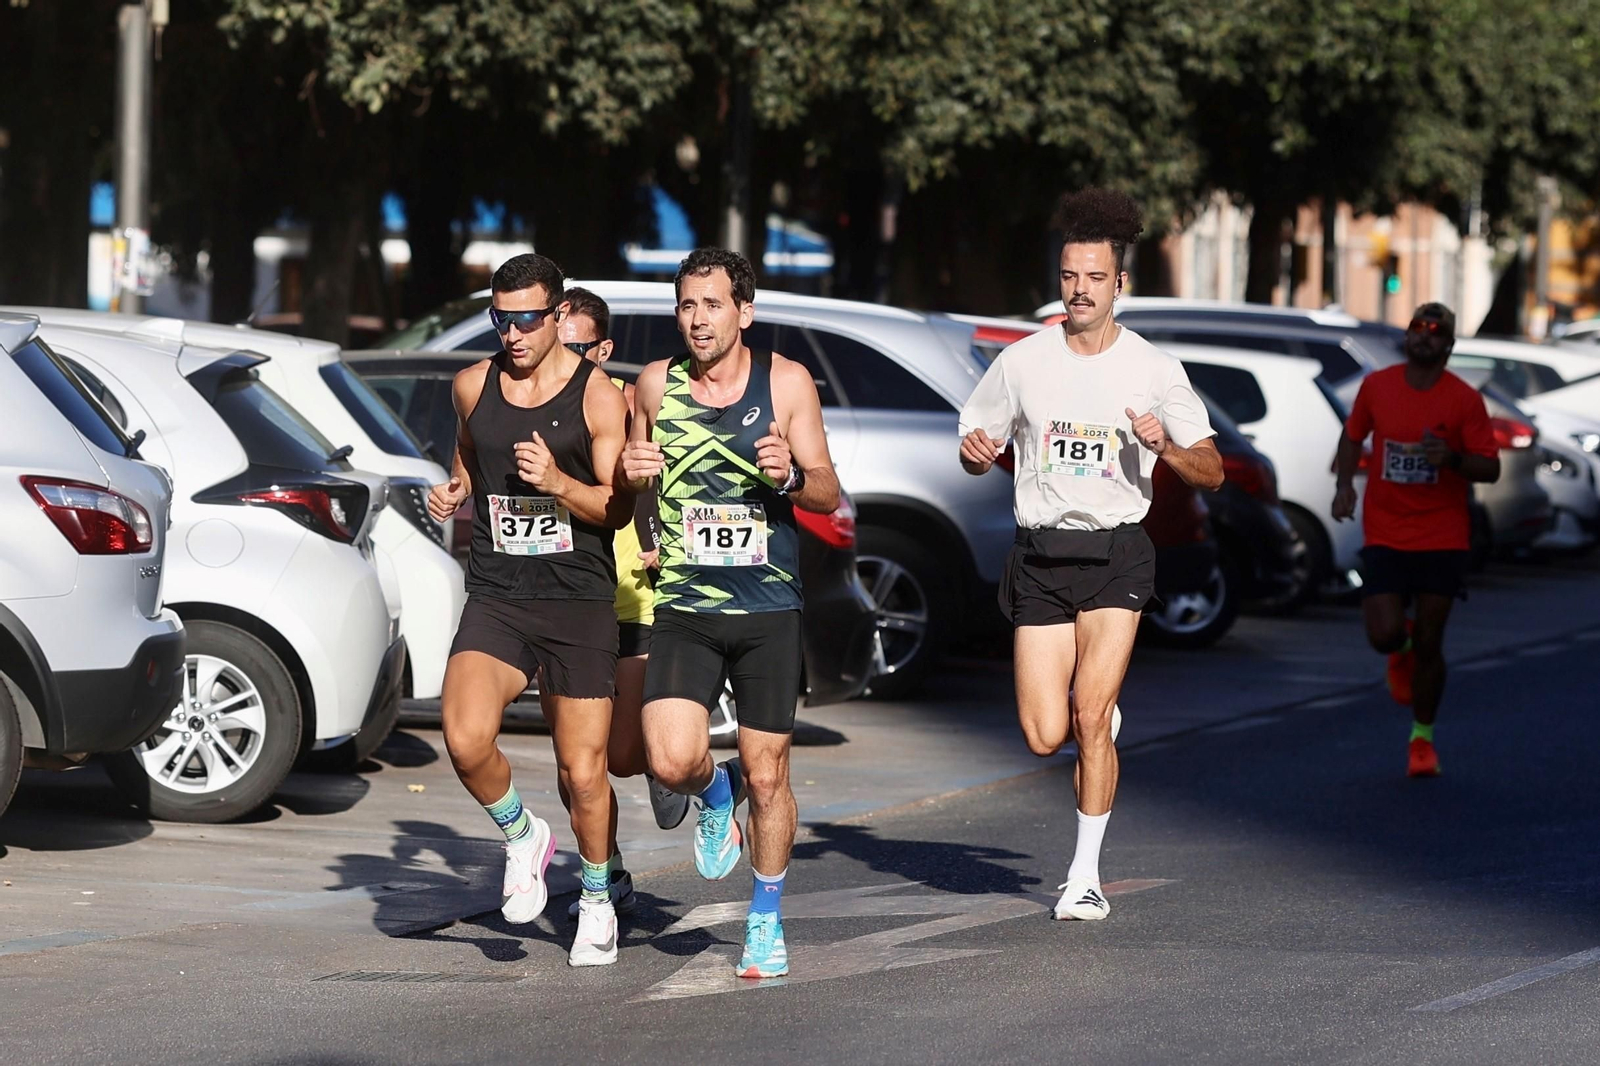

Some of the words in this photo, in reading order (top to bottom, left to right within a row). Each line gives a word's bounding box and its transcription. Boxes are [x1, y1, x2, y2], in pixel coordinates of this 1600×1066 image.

[1083, 429, 1109, 438] 2025
[1052, 439, 1104, 462] 181
[1391, 455, 1428, 471] 282
[528, 504, 556, 512] 2025
[727, 513, 754, 521] 2025
[501, 516, 558, 538] 372
[697, 527, 752, 548] 187
